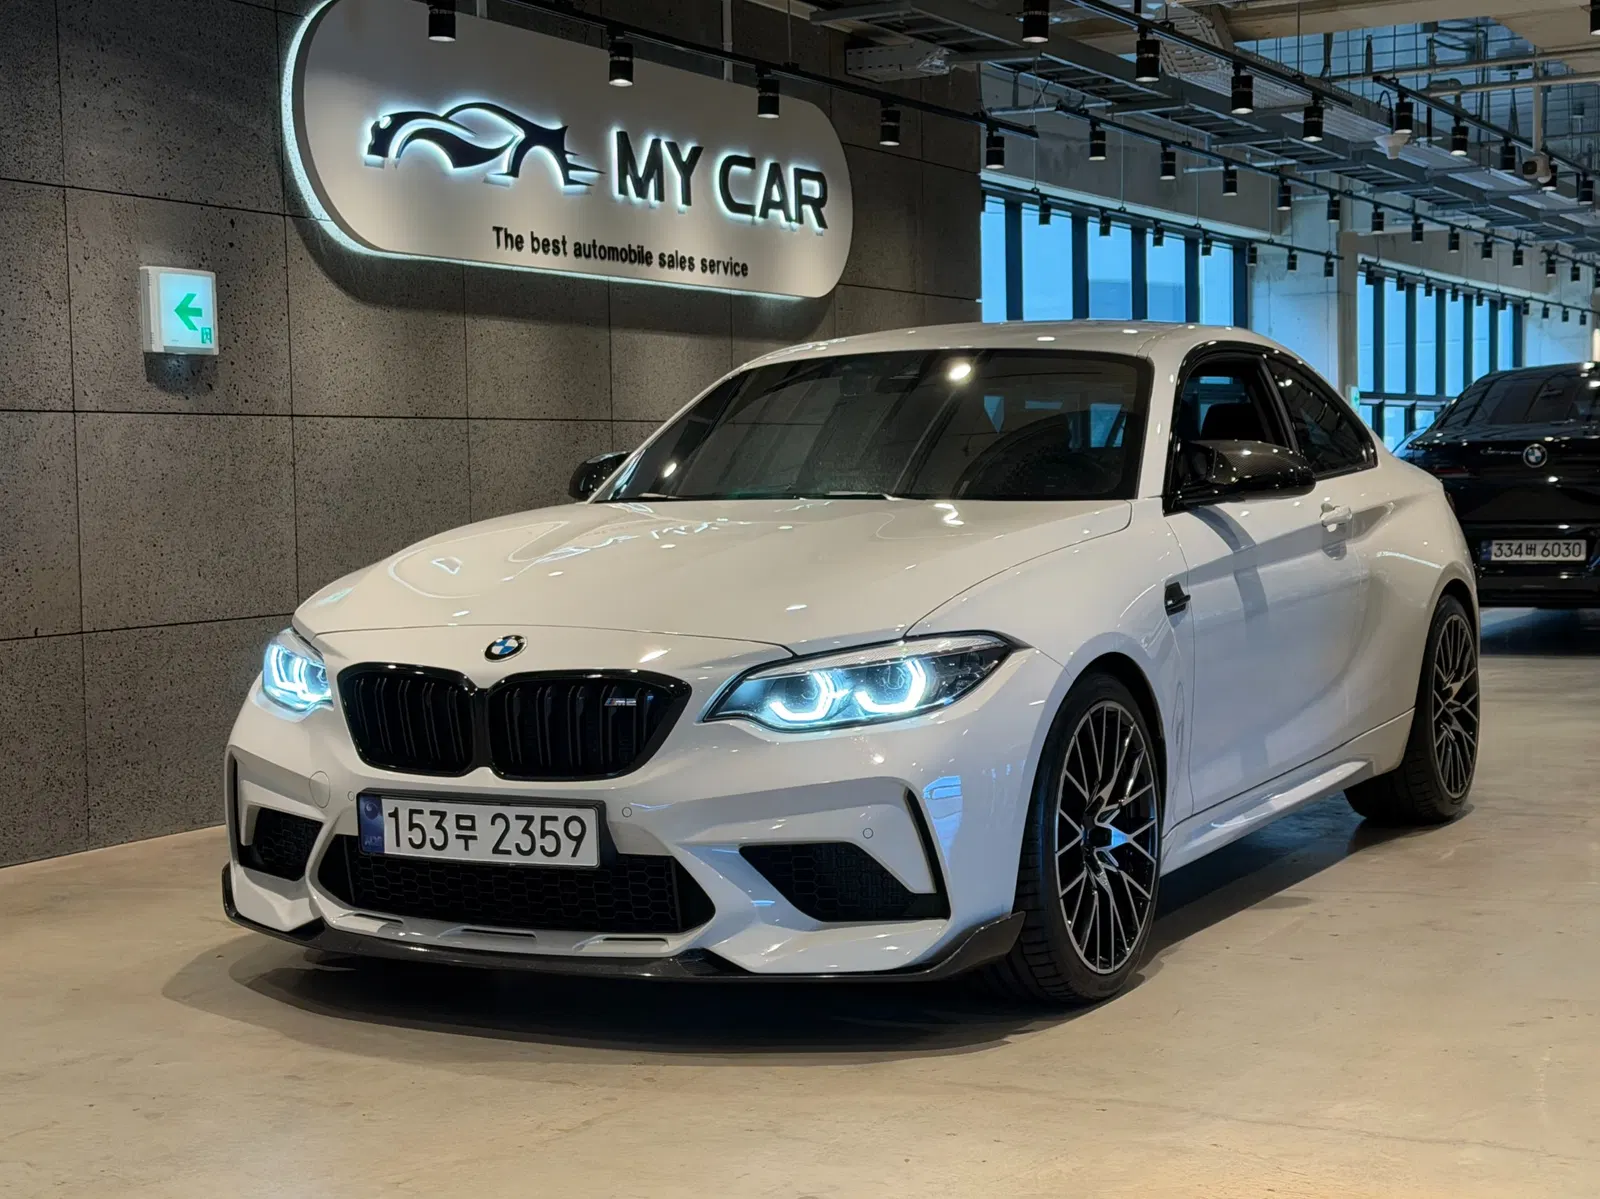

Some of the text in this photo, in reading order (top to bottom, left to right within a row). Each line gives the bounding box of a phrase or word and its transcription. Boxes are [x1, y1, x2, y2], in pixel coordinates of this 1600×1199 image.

[616, 129, 828, 230] MY CAR
[492, 226, 749, 278] The best automobile sales service
[1493, 542, 1582, 558] 334버 6030
[388, 806, 587, 858] 153무 2359
